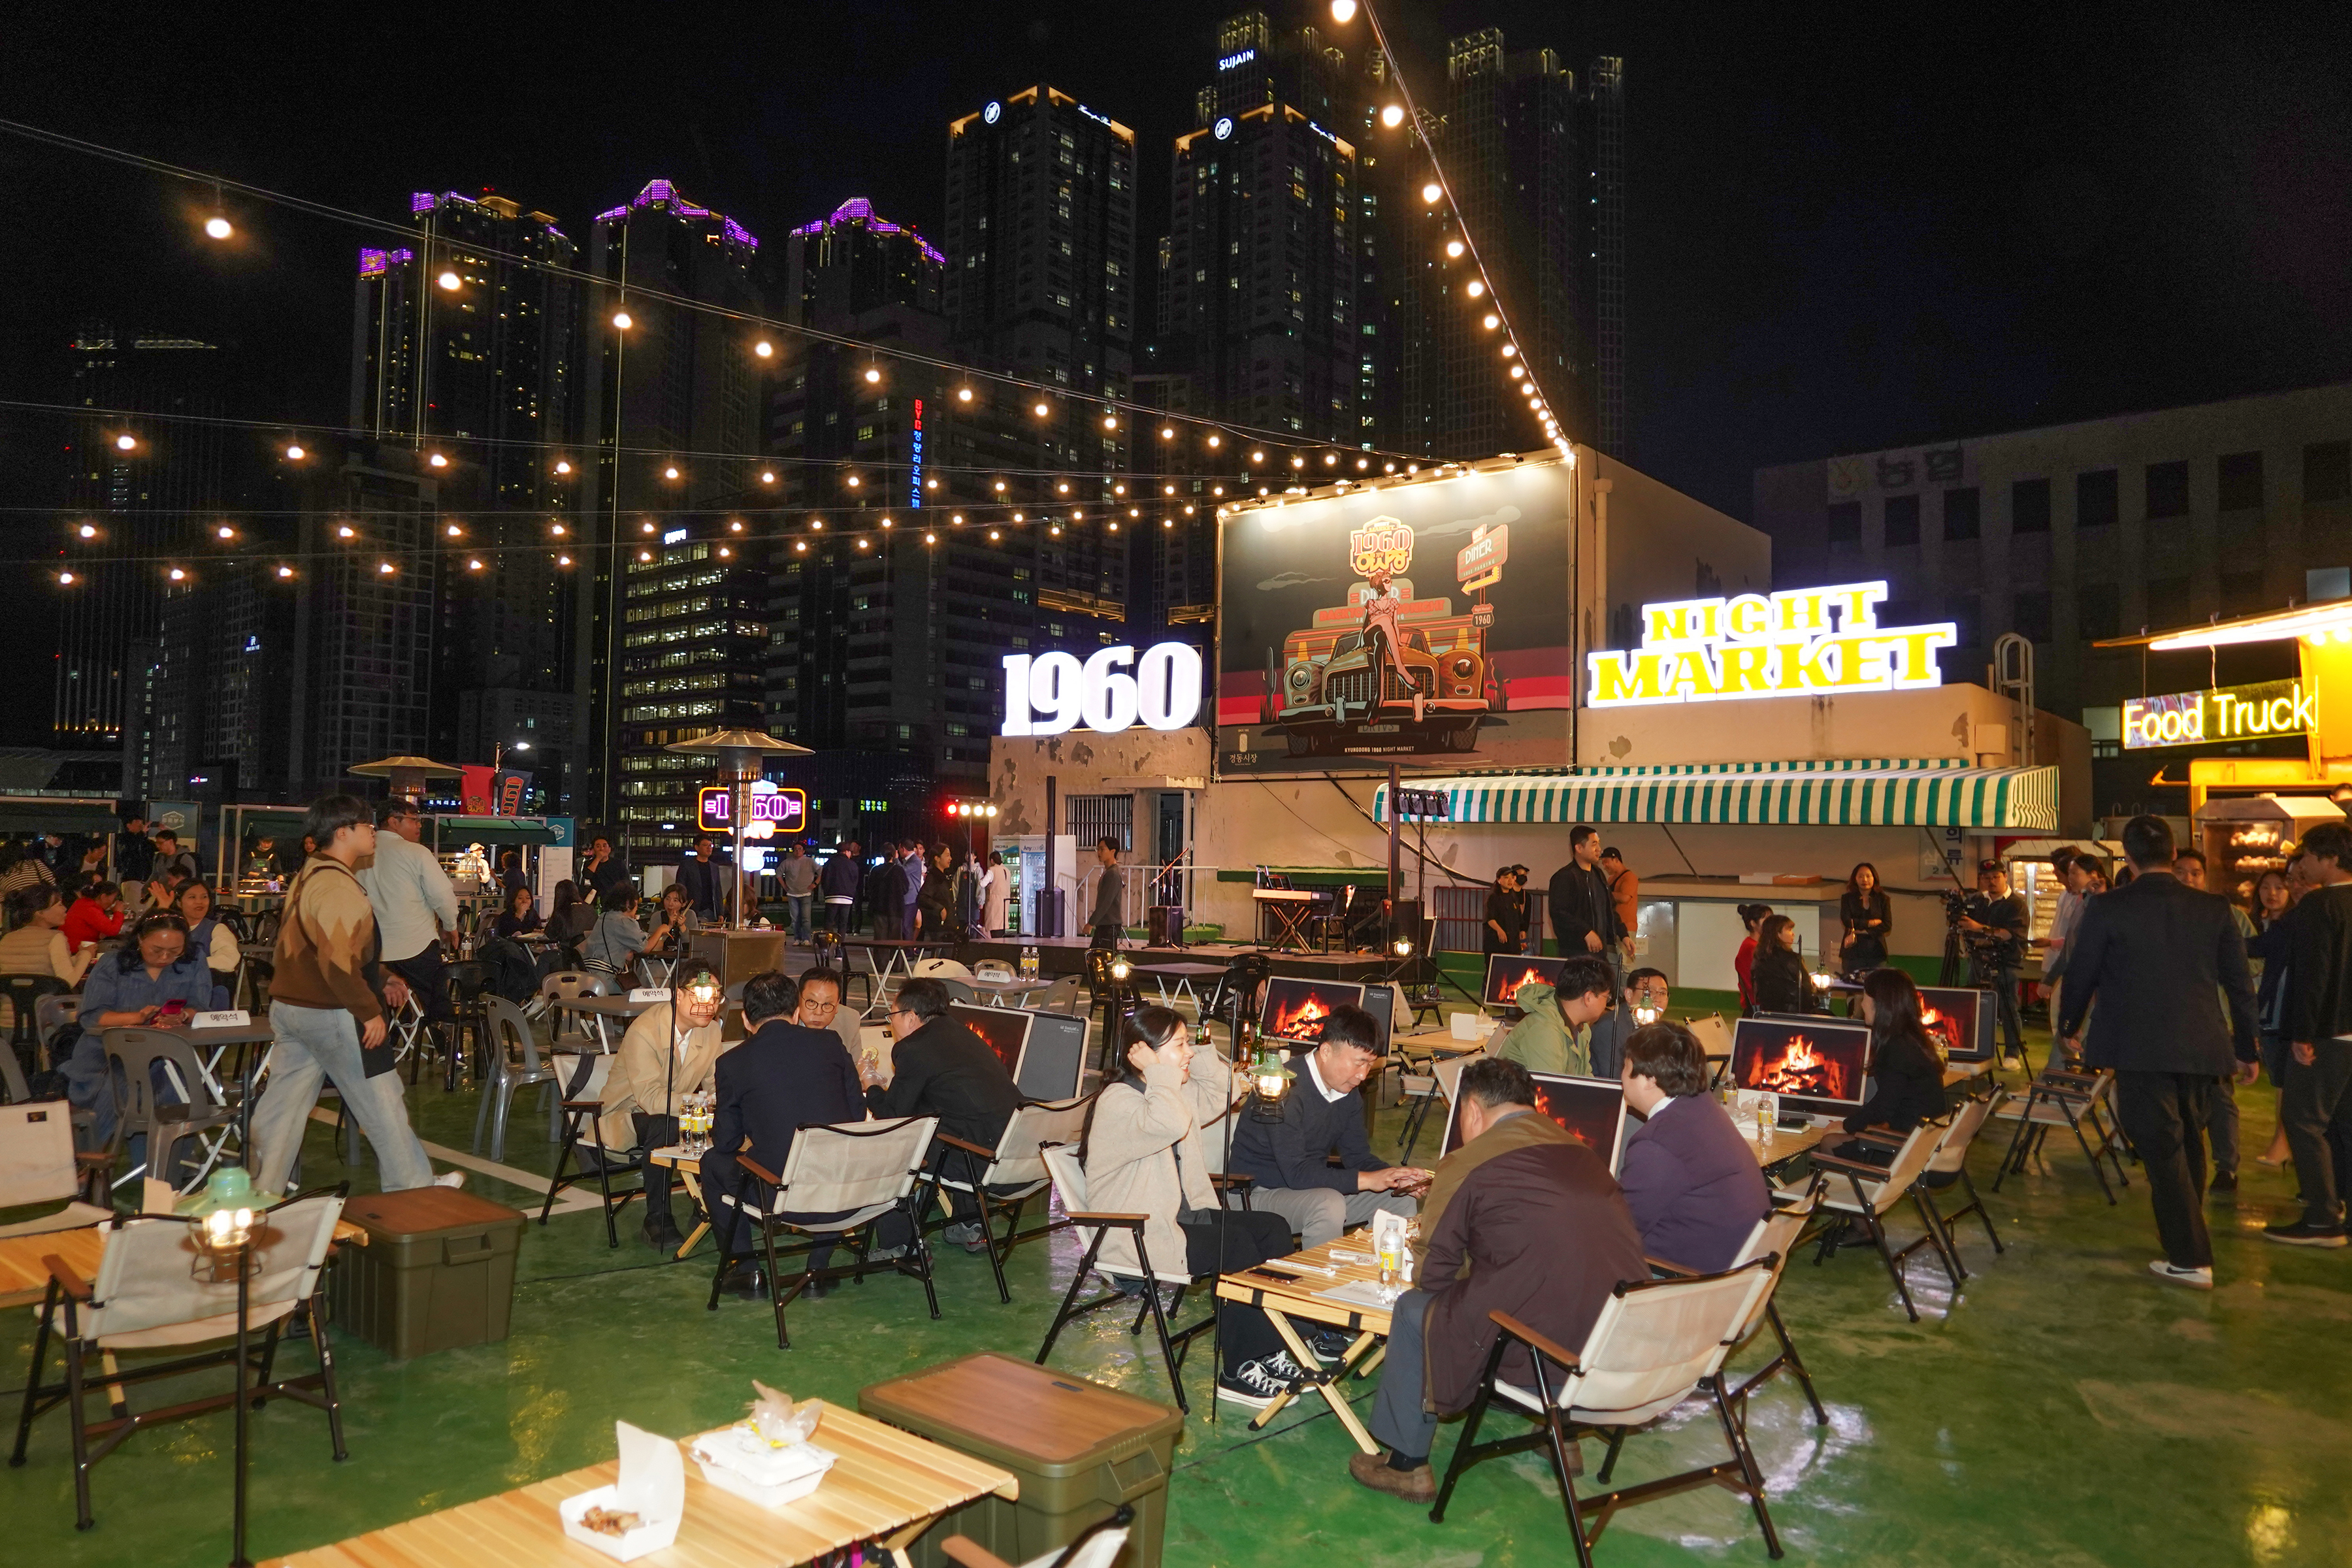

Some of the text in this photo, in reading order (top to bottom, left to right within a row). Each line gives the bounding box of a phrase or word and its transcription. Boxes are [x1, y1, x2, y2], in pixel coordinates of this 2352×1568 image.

[1219, 49, 1254, 71] SUJAIN
[914, 399, 923, 431] BYC
[1354, 529, 1410, 555] 1960
[1465, 538, 1492, 564] DINER
[1475, 559, 1495, 572] PARKING
[1475, 615, 1491, 625] 1960
[1643, 582, 1886, 647] NIGHT
[1588, 624, 1955, 707] MARKET
[1002, 642, 1203, 736] 1960
[2123, 683, 2315, 744] Food Truck
[1230, 753, 1258, 764] 경동시장
[715, 794, 789, 820] 160
[210, 1013, 238, 1022] 예약석
